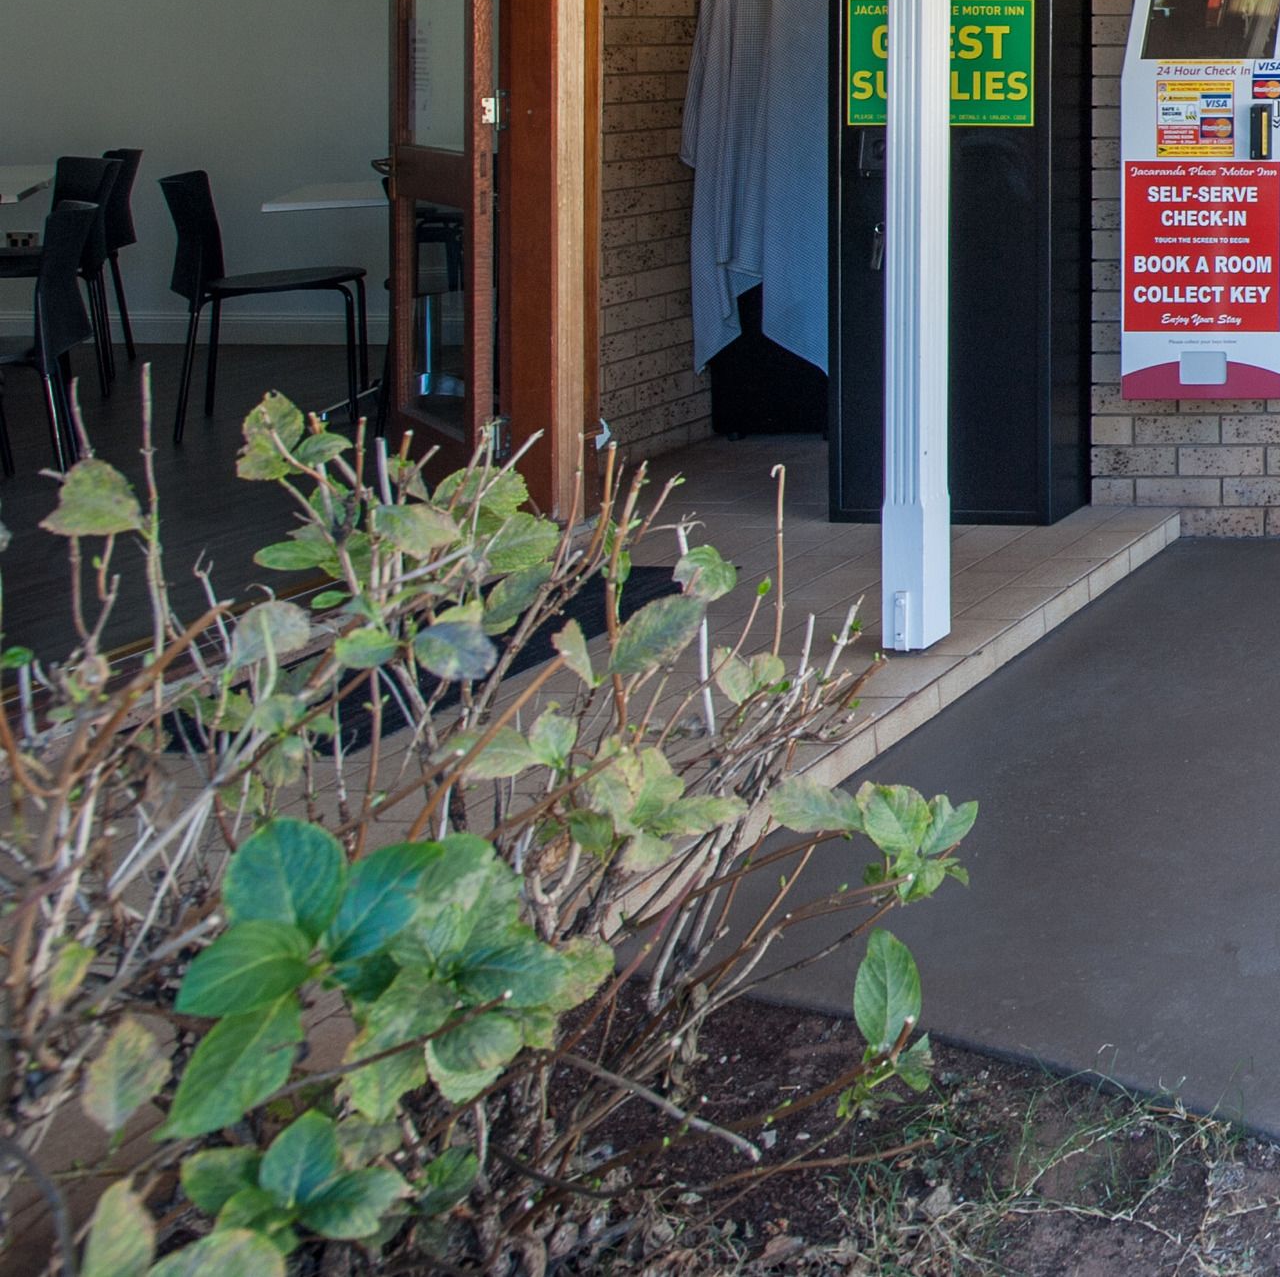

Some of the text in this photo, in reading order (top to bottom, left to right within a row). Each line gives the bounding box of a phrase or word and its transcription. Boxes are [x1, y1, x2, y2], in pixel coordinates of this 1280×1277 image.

[854, 5, 888, 15] JACAR
[963, 5, 1001, 15] MOTOR
[1004, 5, 1025, 16] INN
[872, 25, 1010, 60] GST
[1157, 65, 1251, 76] 24 Hour Check In
[852, 70, 1028, 101] SLIES
[1205, 99, 1228, 108] VISA
[1131, 166, 1278, 177] Jacaranda Place Motor Inn
[1147, 186, 1258, 202] SELF-SERVE
[1161, 210, 1247, 226] CHECK-IN
[1133, 256, 1272, 273] BOOK A ROOM
[1133, 286, 1271, 303] COLLECT KEY
[1161, 313, 1242, 325] Enjoy Your Stay
